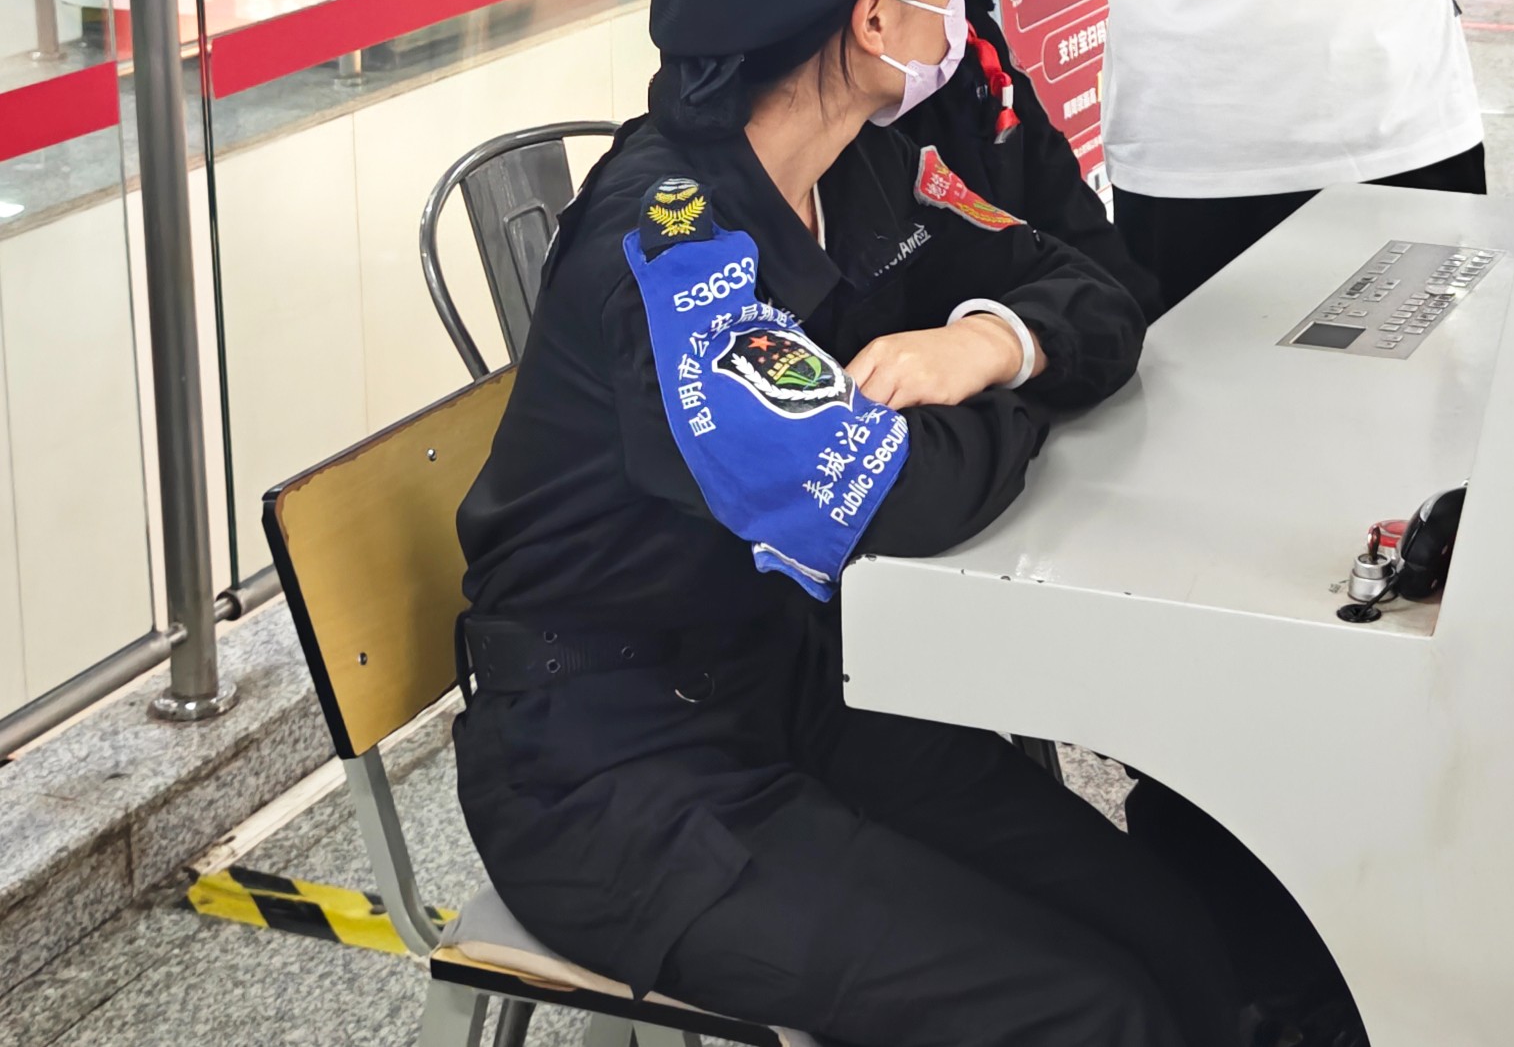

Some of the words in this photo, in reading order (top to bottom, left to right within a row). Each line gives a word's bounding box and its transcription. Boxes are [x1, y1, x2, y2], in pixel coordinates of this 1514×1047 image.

[1058, 19, 1108, 65] 支付宝扫码
[672, 256, 756, 313] 53633
[830, 474, 874, 527] Public
